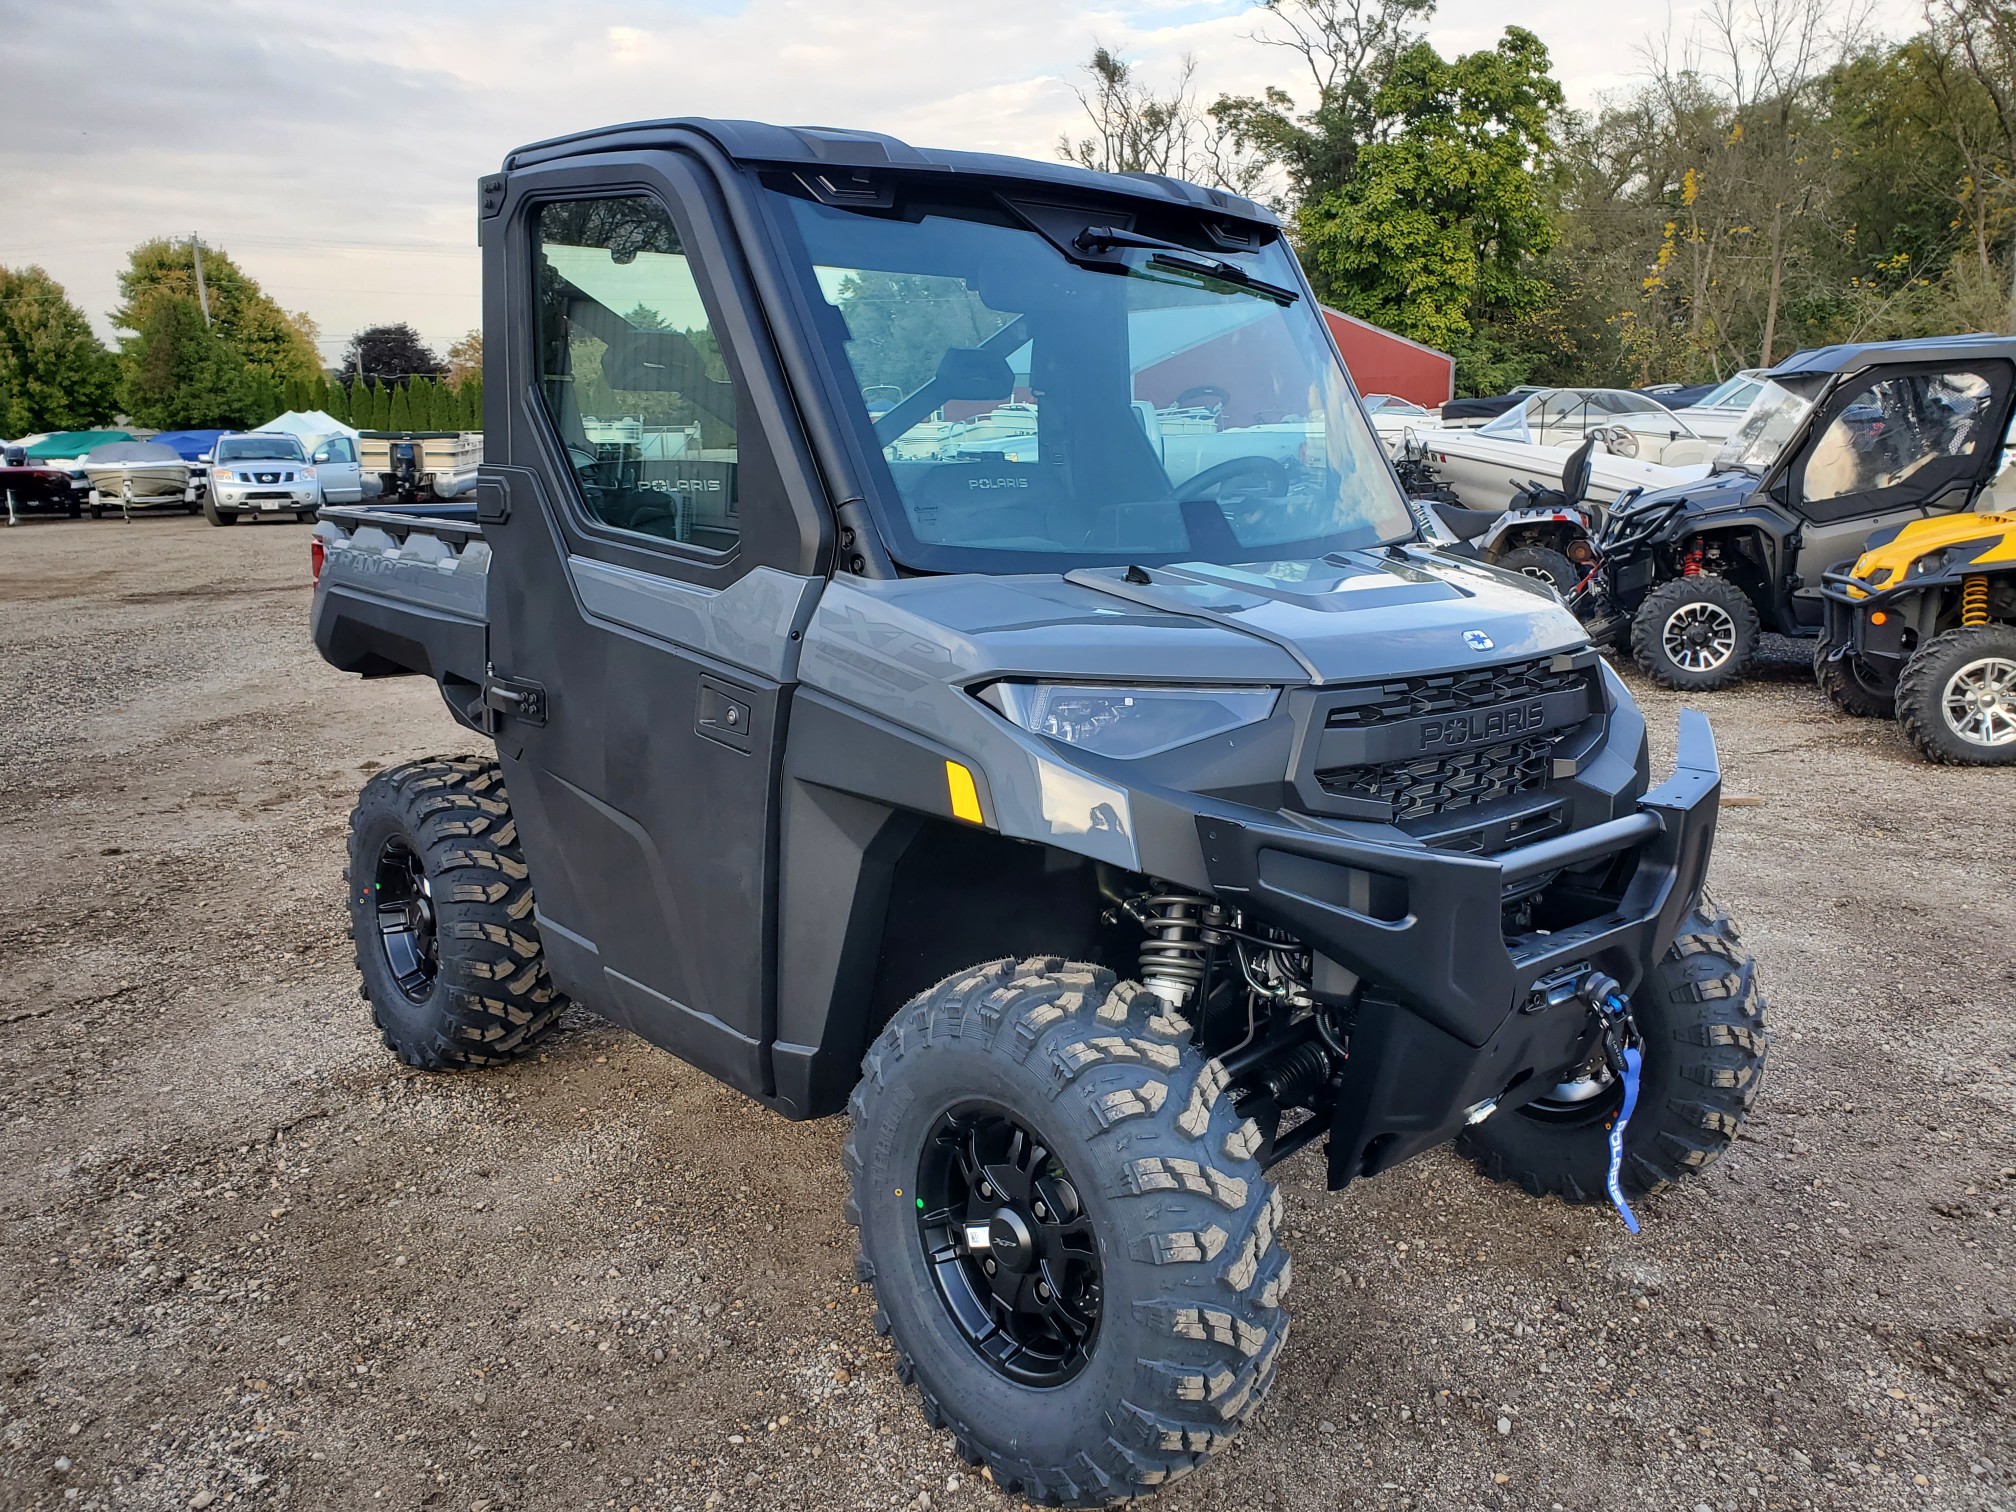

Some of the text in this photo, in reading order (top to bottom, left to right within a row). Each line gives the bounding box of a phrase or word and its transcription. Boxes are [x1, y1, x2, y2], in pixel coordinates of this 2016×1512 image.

[637, 479, 721, 492] POLARIS
[967, 478, 1029, 490] POLARIS
[1419, 701, 1545, 751] POLARIS
[1608, 1119, 1628, 1206] POLARIS
